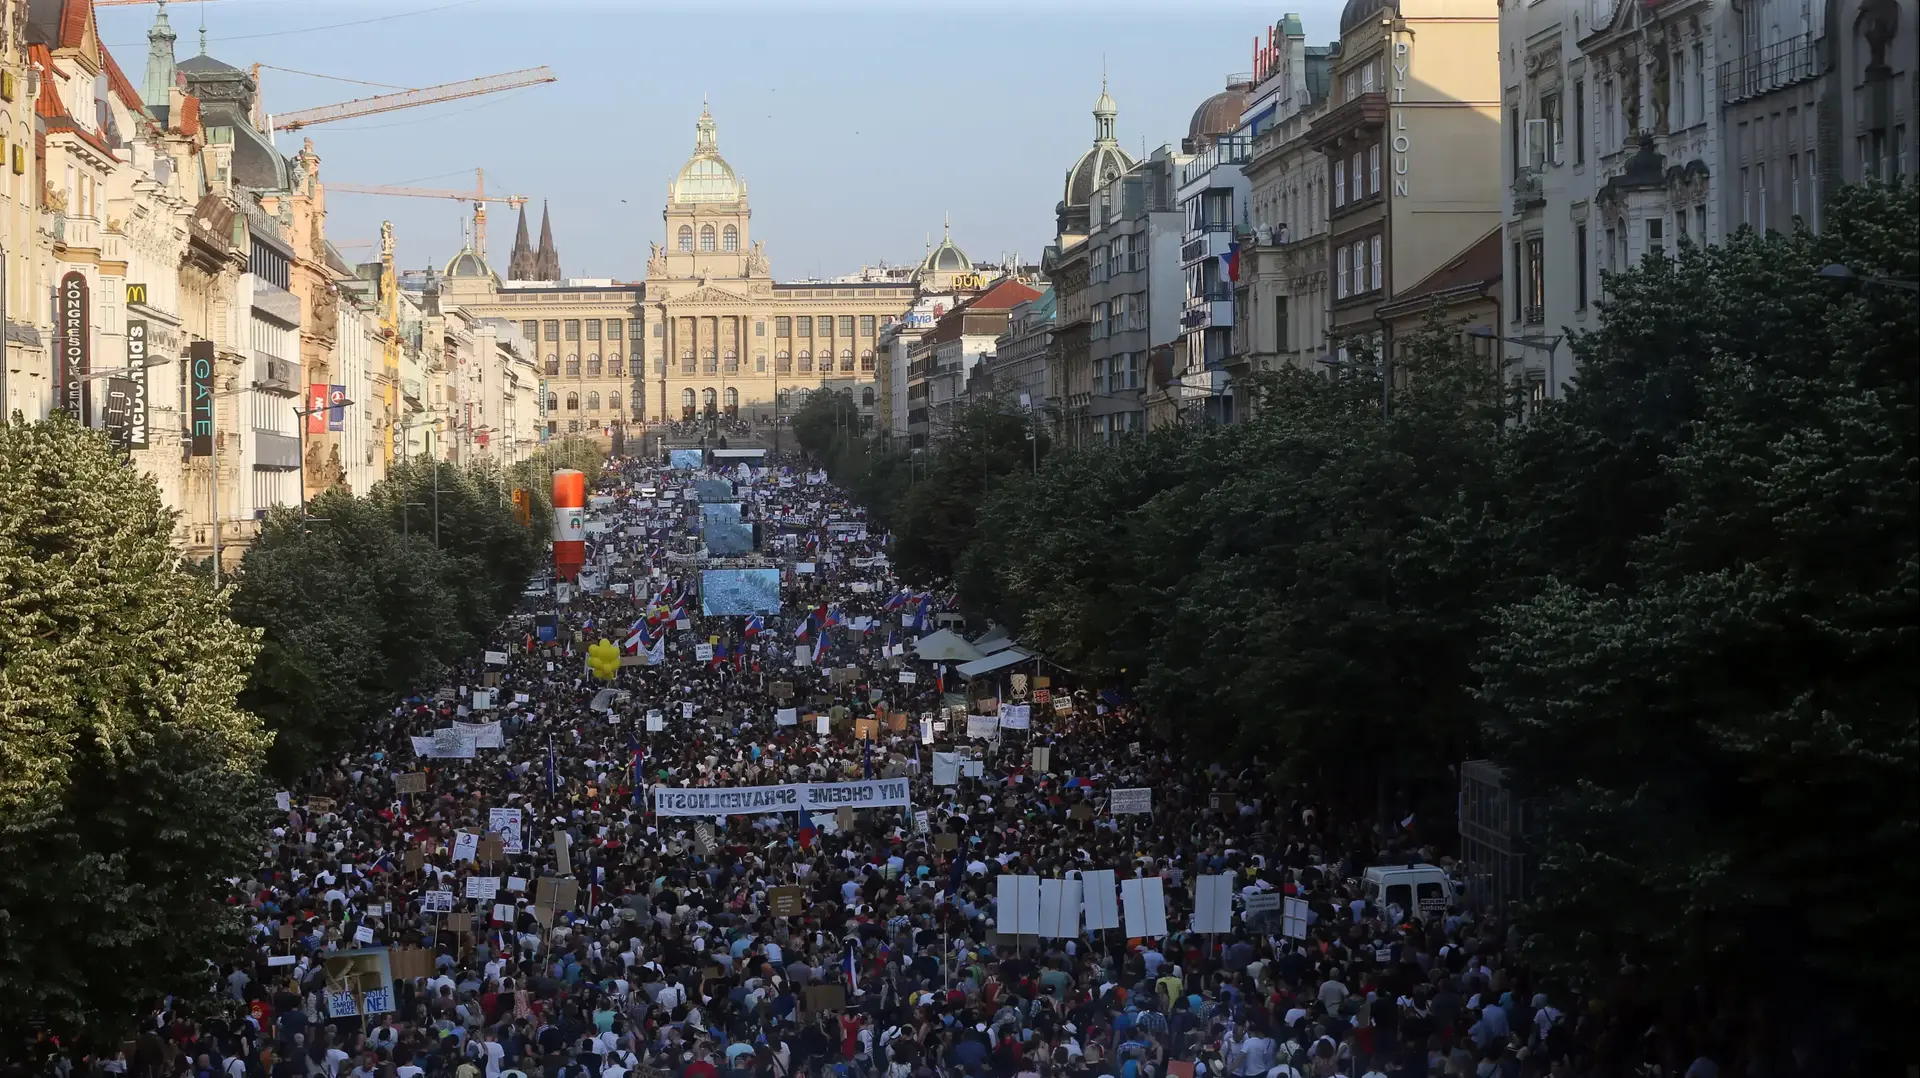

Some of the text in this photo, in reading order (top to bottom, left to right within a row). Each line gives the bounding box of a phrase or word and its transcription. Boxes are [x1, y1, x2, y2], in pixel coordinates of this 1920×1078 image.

[1393, 42, 1410, 197] PYTLOUN
[129, 325, 145, 444] McDonald's
[194, 358, 211, 437] GATE
[367, 997, 387, 1012] NE!
